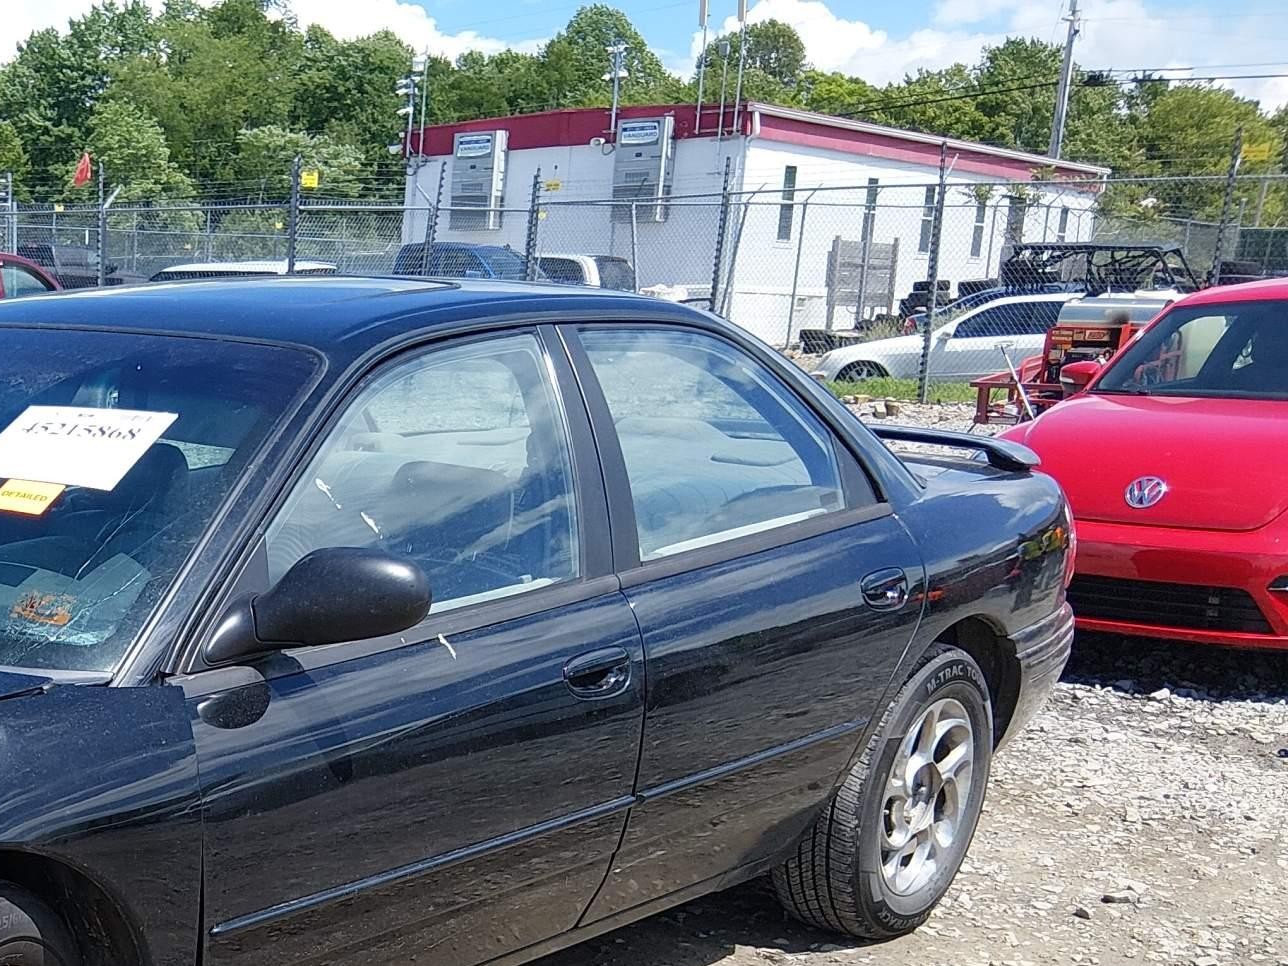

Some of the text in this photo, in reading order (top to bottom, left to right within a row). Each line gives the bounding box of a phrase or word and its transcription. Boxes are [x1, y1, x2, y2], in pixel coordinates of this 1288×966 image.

[623, 131, 658, 139] VANGUARD
[459, 144, 490, 153] VANGUARD
[0, 490, 48, 502] DETAILED
[926, 664, 964, 696] M-TRAC
